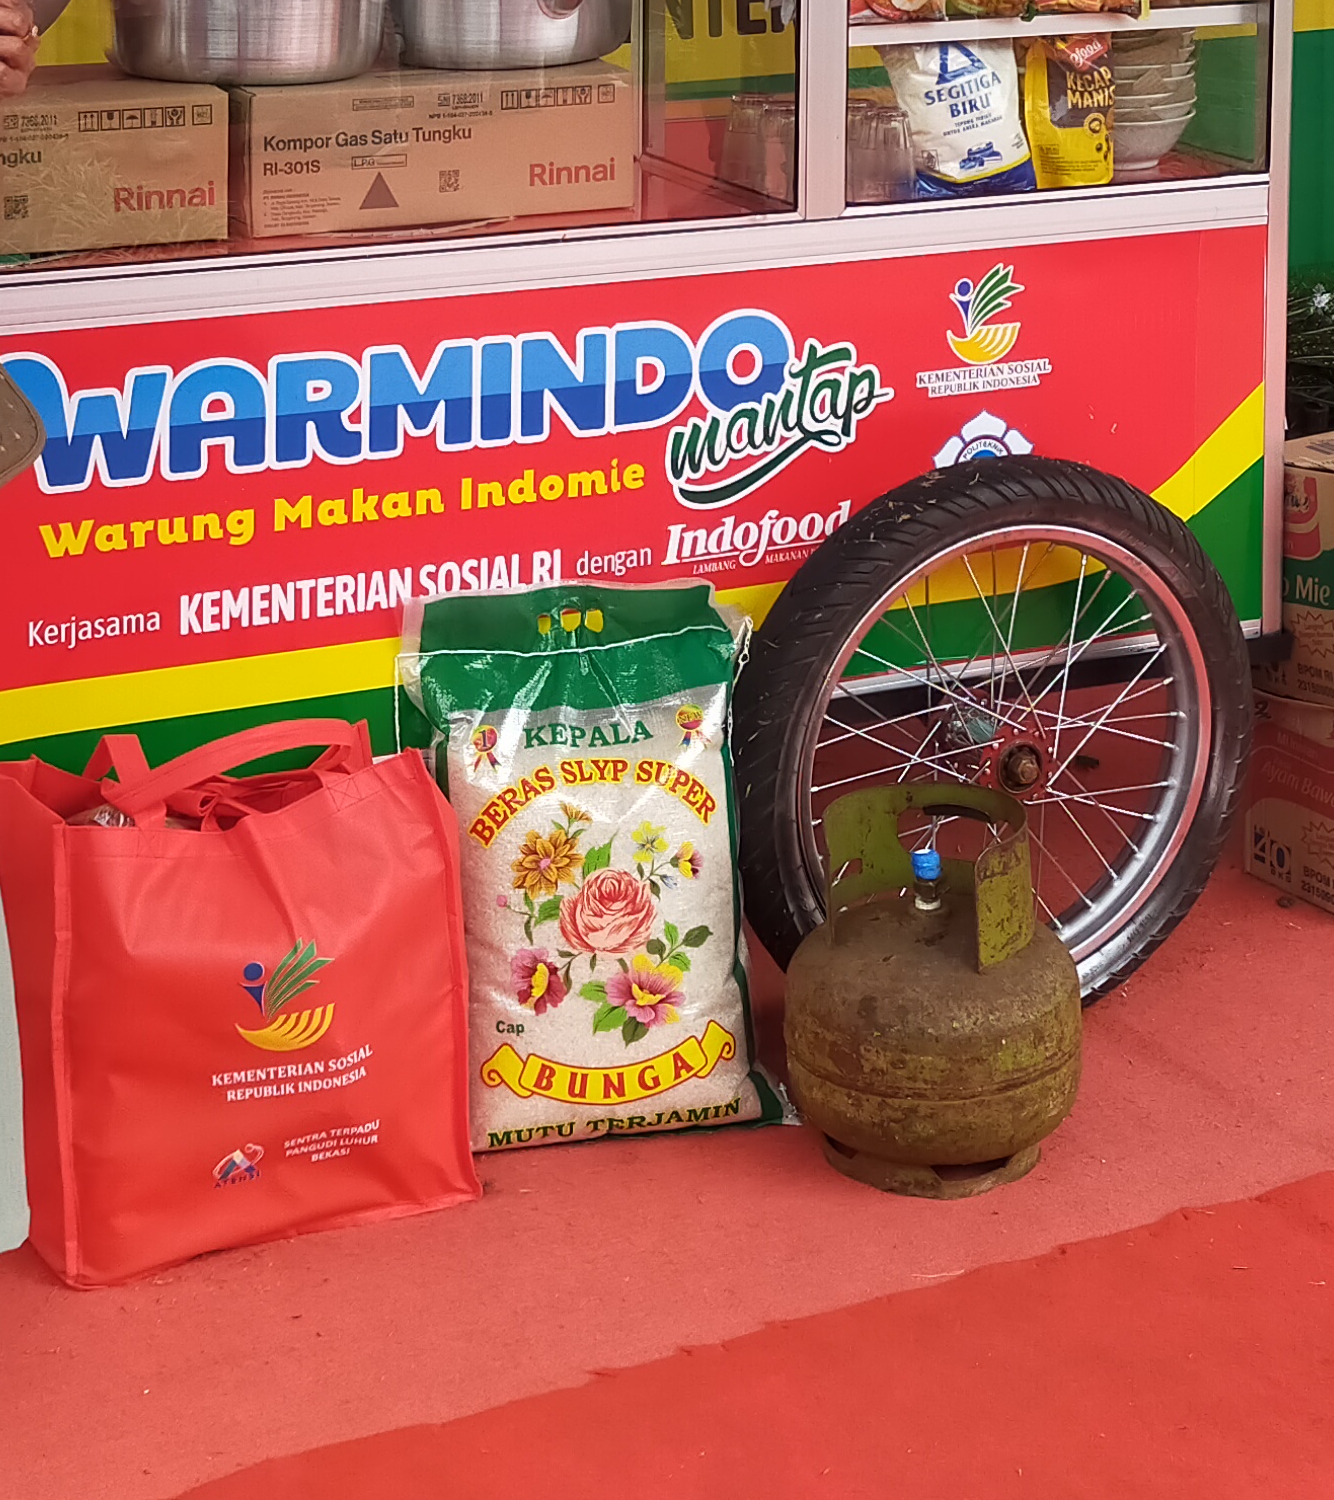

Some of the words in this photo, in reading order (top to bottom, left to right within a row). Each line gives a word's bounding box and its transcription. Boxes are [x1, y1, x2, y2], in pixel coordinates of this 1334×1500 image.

[924, 71, 1002, 106] SEGITIGA
[1067, 66, 1113, 92] KECAP
[949, 93, 991, 119] BIRU
[1067, 85, 1116, 110] MANIS
[263, 135, 331, 154] Kompor
[335, 131, 368, 148] Gas
[371, 128, 409, 146] Satu
[412, 124, 473, 145] Tungku
[263, 160, 321, 177] RI-301S
[529, 156, 616, 188] Rinnai
[113, 179, 216, 213] Rinnai
[918, 364, 1006, 386] KEMENTERIAN
[1007, 359, 1050, 376] SOSIAL
[930, 379, 980, 396] REPUBLIK
[982, 374, 1039, 390] INDONESIA
[664, 336, 895, 511] mantap
[963, 440, 1005, 460] POLITEKNIK
[39, 506, 255, 559] Warung
[273, 482, 445, 533] Makan
[460, 458, 646, 511] Indomie
[692, 558, 737, 576] LAMBANG
[765, 547, 808, 565] MAKANAN
[27, 609, 161, 650] Kerjasama
[178, 567, 413, 637] KEMENTERIAN
[418, 551, 523, 600] SOSIAL
[531, 548, 562, 586] RI
[575, 545, 652, 577] dengan
[1295, 574, 1332, 608] Mie
[523, 719, 654, 750] KEPALA
[1261, 760, 1299, 791] Ayam
[469, 765, 557, 849] BERAS
[560, 757, 629, 786] SLYP
[634, 759, 718, 827] SUPER
[1302, 865, 1331, 887] BPOM
[496, 1019, 525, 1036] Cap
[211, 1060, 325, 1087] KEMENTERIAN
[328, 1043, 374, 1072] SOSIAL
[532, 1052, 696, 1100] BUNGA
[226, 1081, 296, 1102] REPUBLIK
[298, 1066, 367, 1094] INDONESIA
[283, 1130, 328, 1150] SENTRA
[329, 1118, 381, 1138] TERPADU
[487, 1122, 577, 1149] MUTU
[586, 1097, 742, 1133] TERJAMIN
[285, 1140, 338, 1158] PANGUDI
[339, 1134, 379, 1148] LUHUR
[310, 1147, 351, 1164] BEKASI
